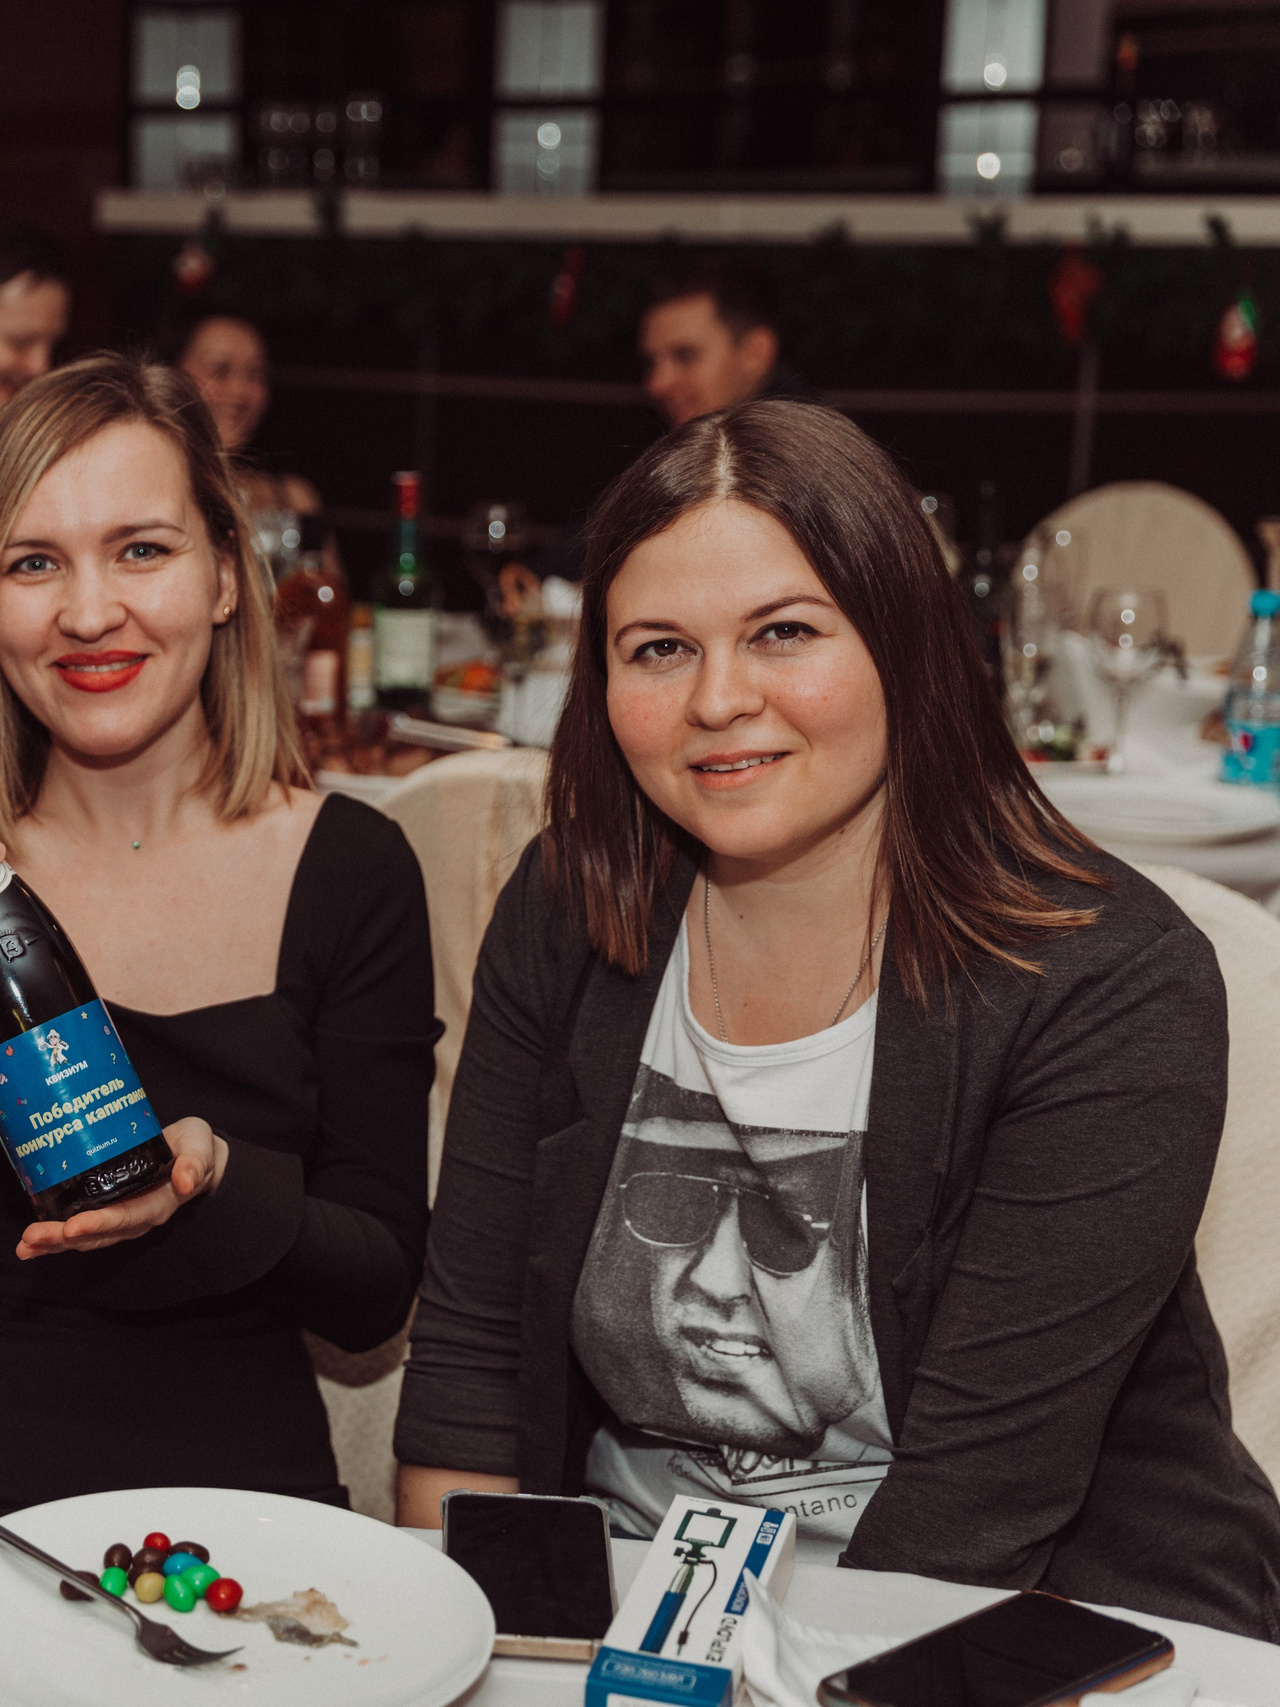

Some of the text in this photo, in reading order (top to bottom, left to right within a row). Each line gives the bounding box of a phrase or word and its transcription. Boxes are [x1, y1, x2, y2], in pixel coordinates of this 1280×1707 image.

[44, 1059, 89, 1086] КВИЗИУМ
[29, 1077, 125, 1130] Победитель
[15, 1116, 85, 1158] конкурса
[85, 1137, 118, 1156] quizium.ru
